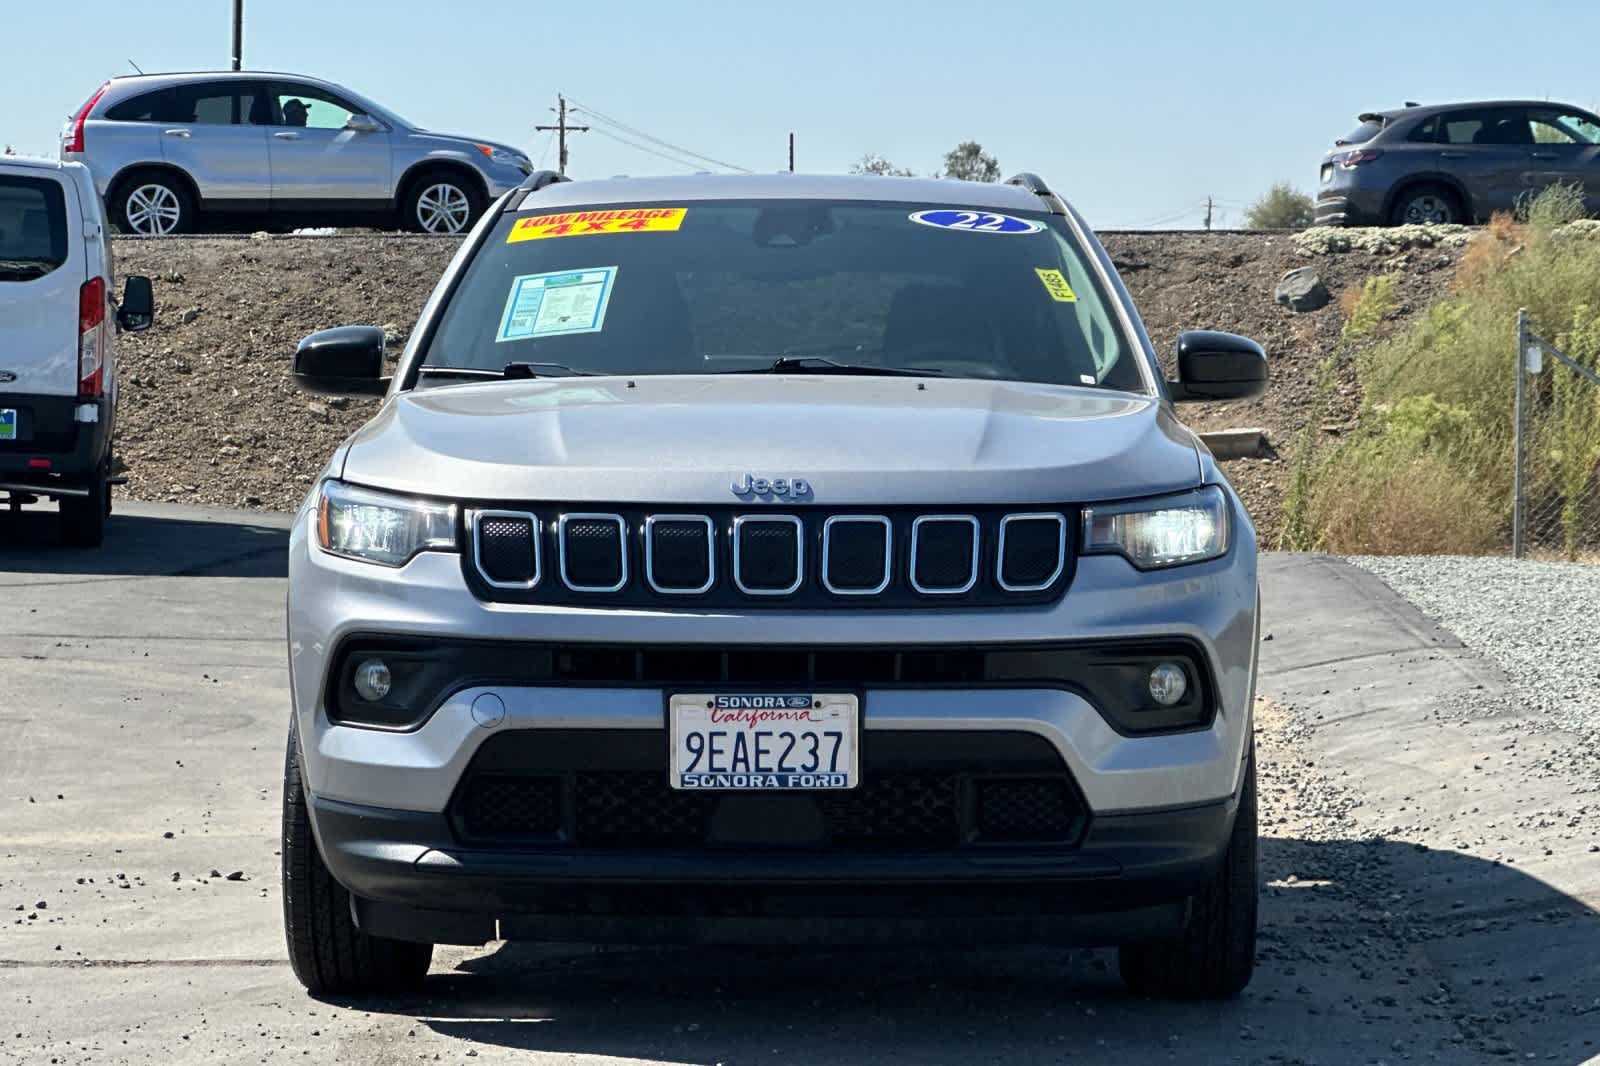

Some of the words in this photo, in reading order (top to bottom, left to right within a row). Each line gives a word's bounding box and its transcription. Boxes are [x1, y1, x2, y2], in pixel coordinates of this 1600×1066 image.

[520, 214, 573, 229] LOW
[574, 208, 674, 223] MILEAGE
[542, 223, 573, 235] 4
[619, 219, 650, 230] 4
[949, 212, 1006, 231] 22
[730, 471, 809, 499] Jeep
[717, 696, 786, 709] SONORA
[710, 708, 822, 729] California
[685, 731, 843, 773] 9EAE237
[683, 774, 779, 788] SONORA
[788, 774, 846, 788] FORD
